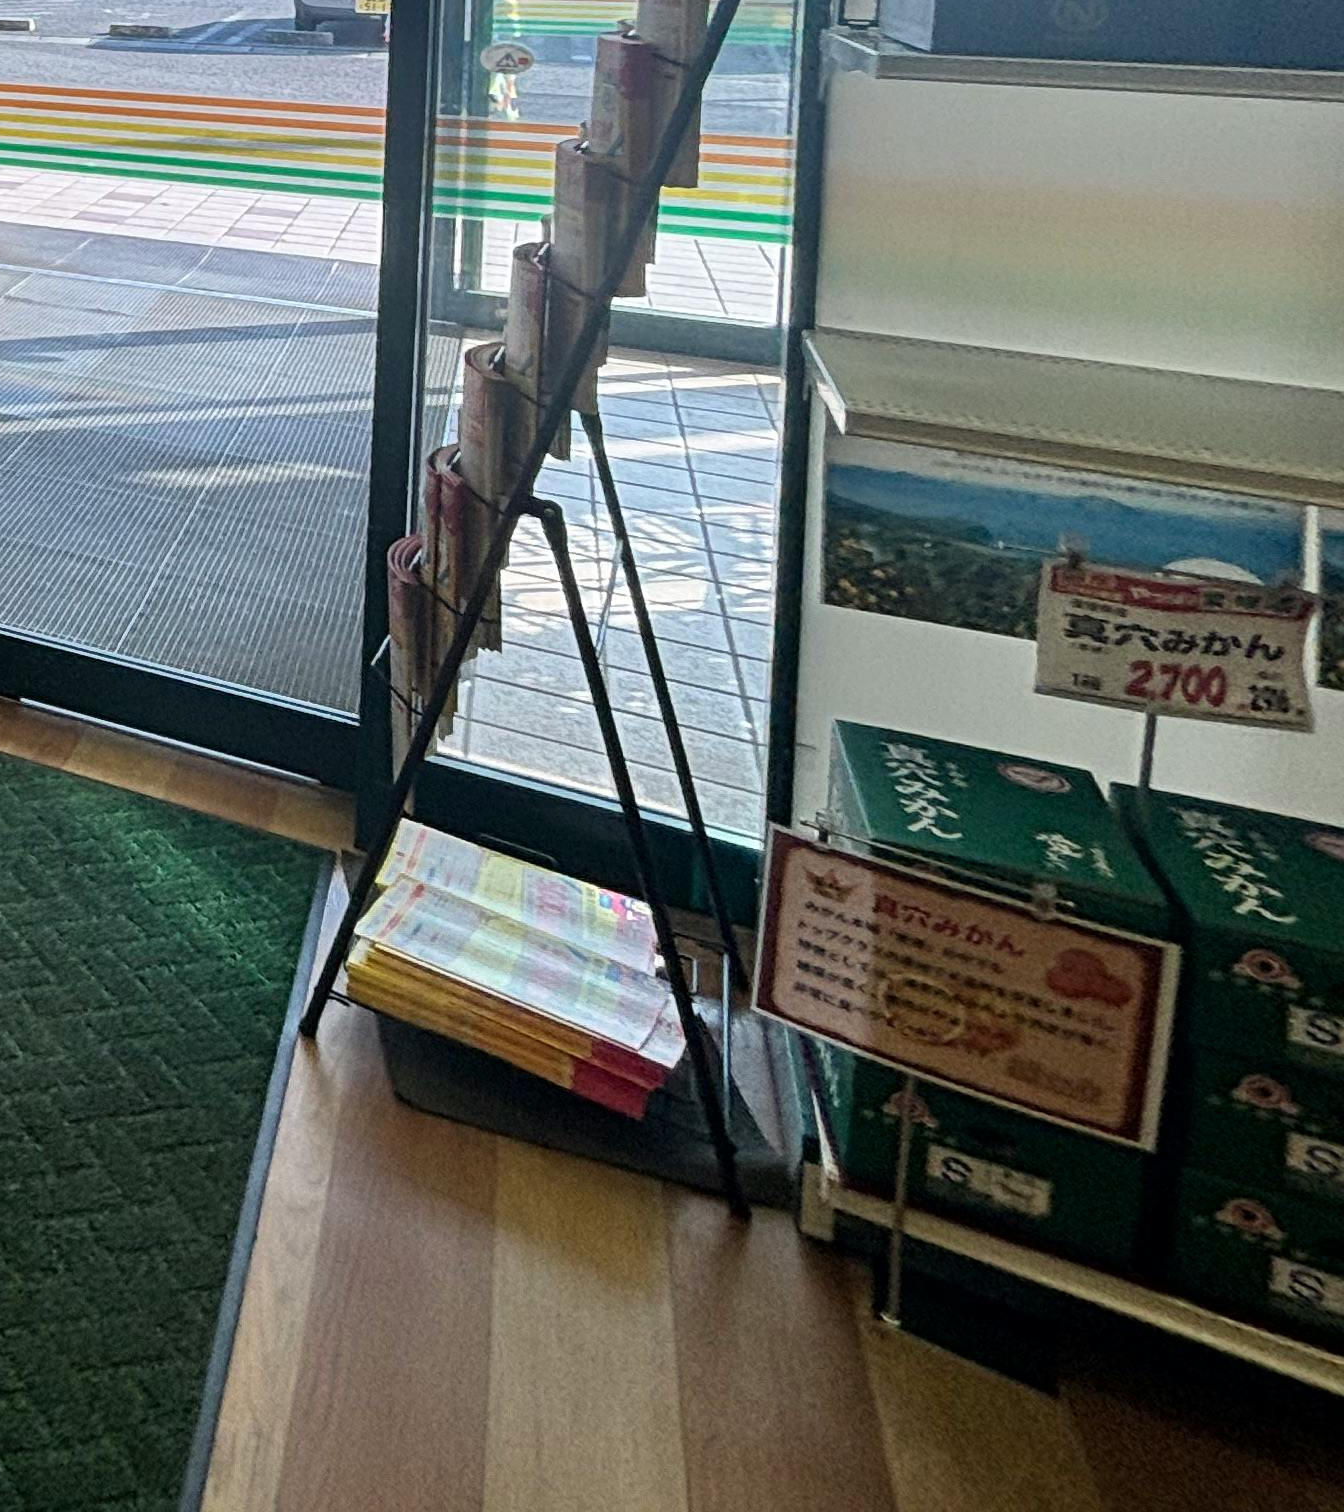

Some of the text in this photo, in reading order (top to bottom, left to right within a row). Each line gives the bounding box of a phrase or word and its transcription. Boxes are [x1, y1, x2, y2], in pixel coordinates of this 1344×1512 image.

[1064, 612, 1285, 662] 真穴みかん
[874, 893, 1027, 958] 真穴みかん
